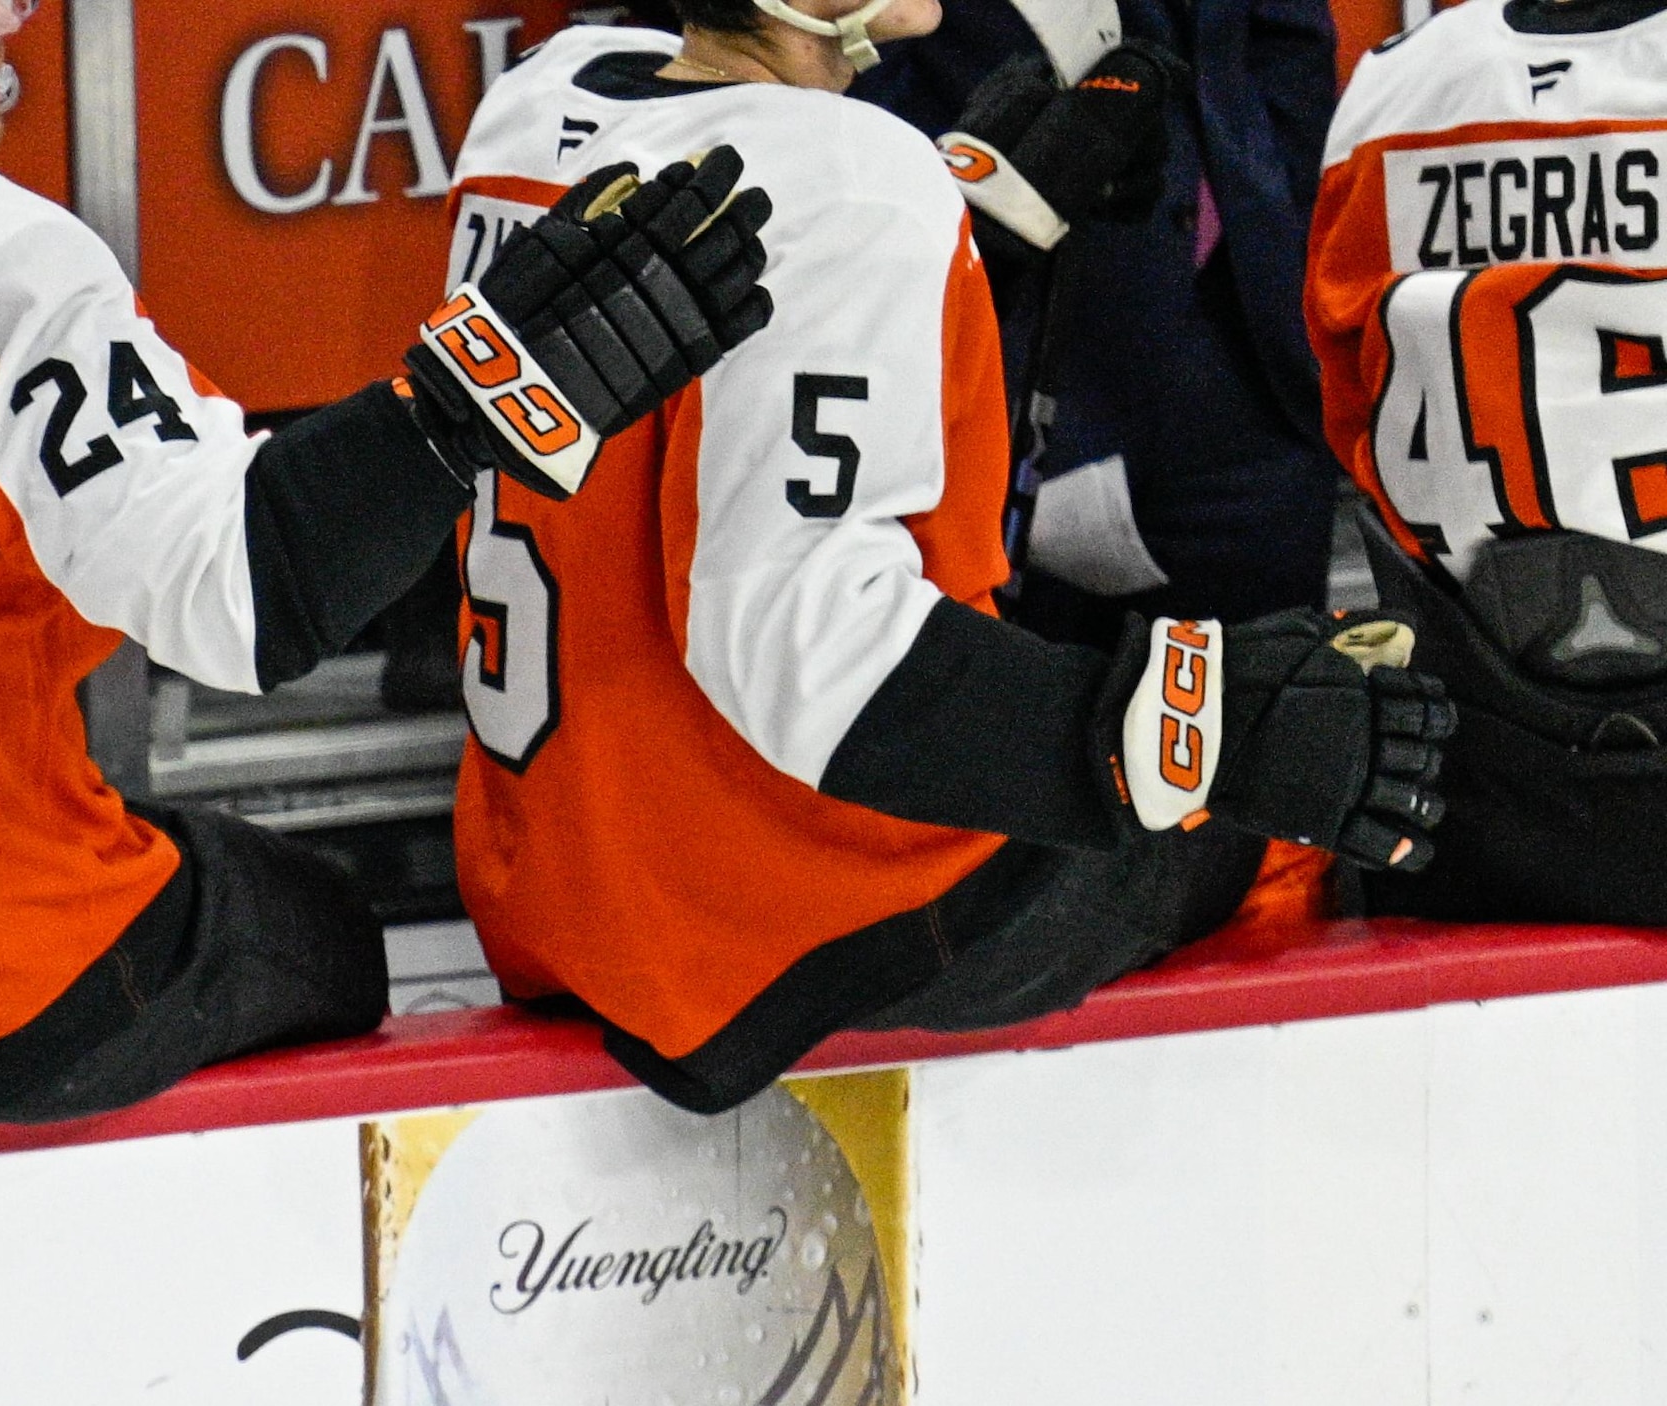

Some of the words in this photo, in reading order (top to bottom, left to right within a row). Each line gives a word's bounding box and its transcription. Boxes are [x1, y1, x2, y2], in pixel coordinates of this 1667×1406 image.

[1417, 148, 1660, 268] ZEGRAS
[10, 340, 198, 498] 24
[784, 373, 868, 519] 5
[489, 1206, 788, 1316] Yuengling
